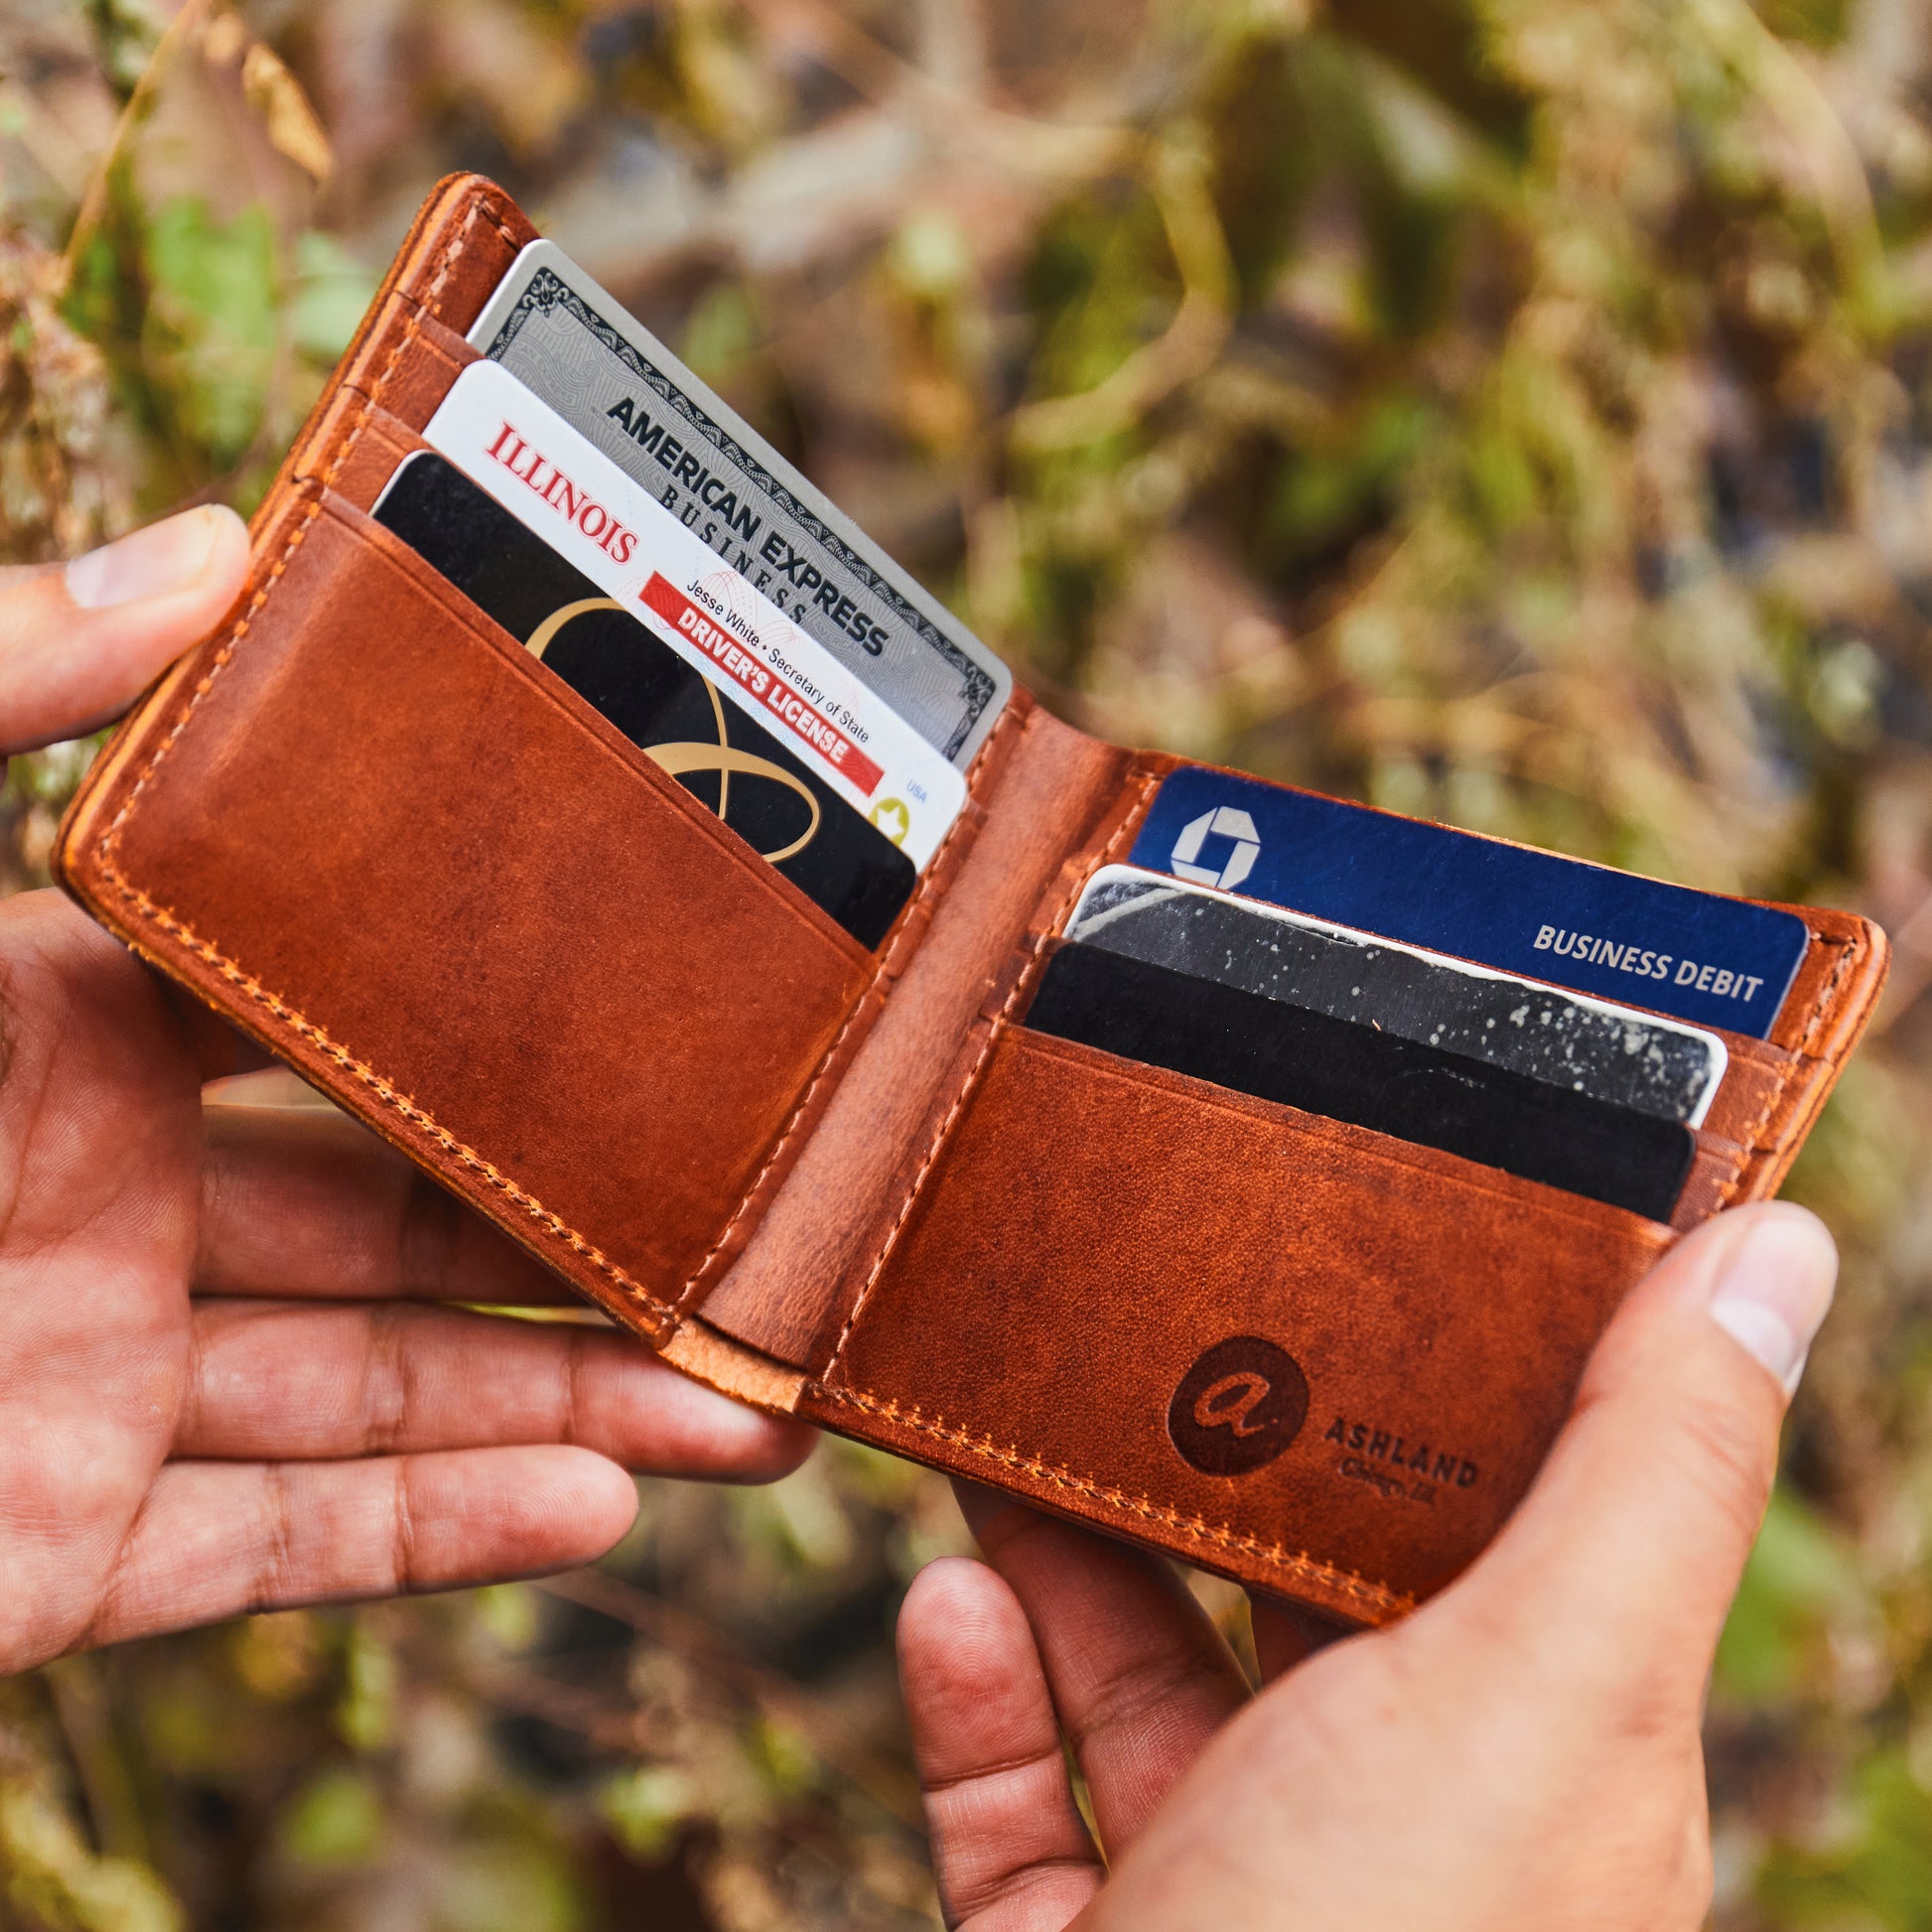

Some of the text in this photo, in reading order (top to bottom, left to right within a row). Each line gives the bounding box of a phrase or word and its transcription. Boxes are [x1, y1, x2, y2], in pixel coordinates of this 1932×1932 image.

[485, 420, 638, 564] ILLINOIS
[606, 396, 762, 542] AMERICAN
[759, 530, 890, 656] EXPRESS
[659, 483, 807, 624] BUSINESS
[676, 606, 768, 695] DRIVER'S
[766, 685, 850, 764] LICENSE
[686, 579, 724, 616] Jesse
[726, 607, 760, 647] White
[767, 647, 826, 706] Secretary
[825, 700, 841, 716] of
[838, 710, 870, 744] State
[904, 777, 929, 804] USA
[1533, 924, 1763, 1002] BUSINESS DEBIT
[1323, 1416, 1479, 1488] ASHLAND
